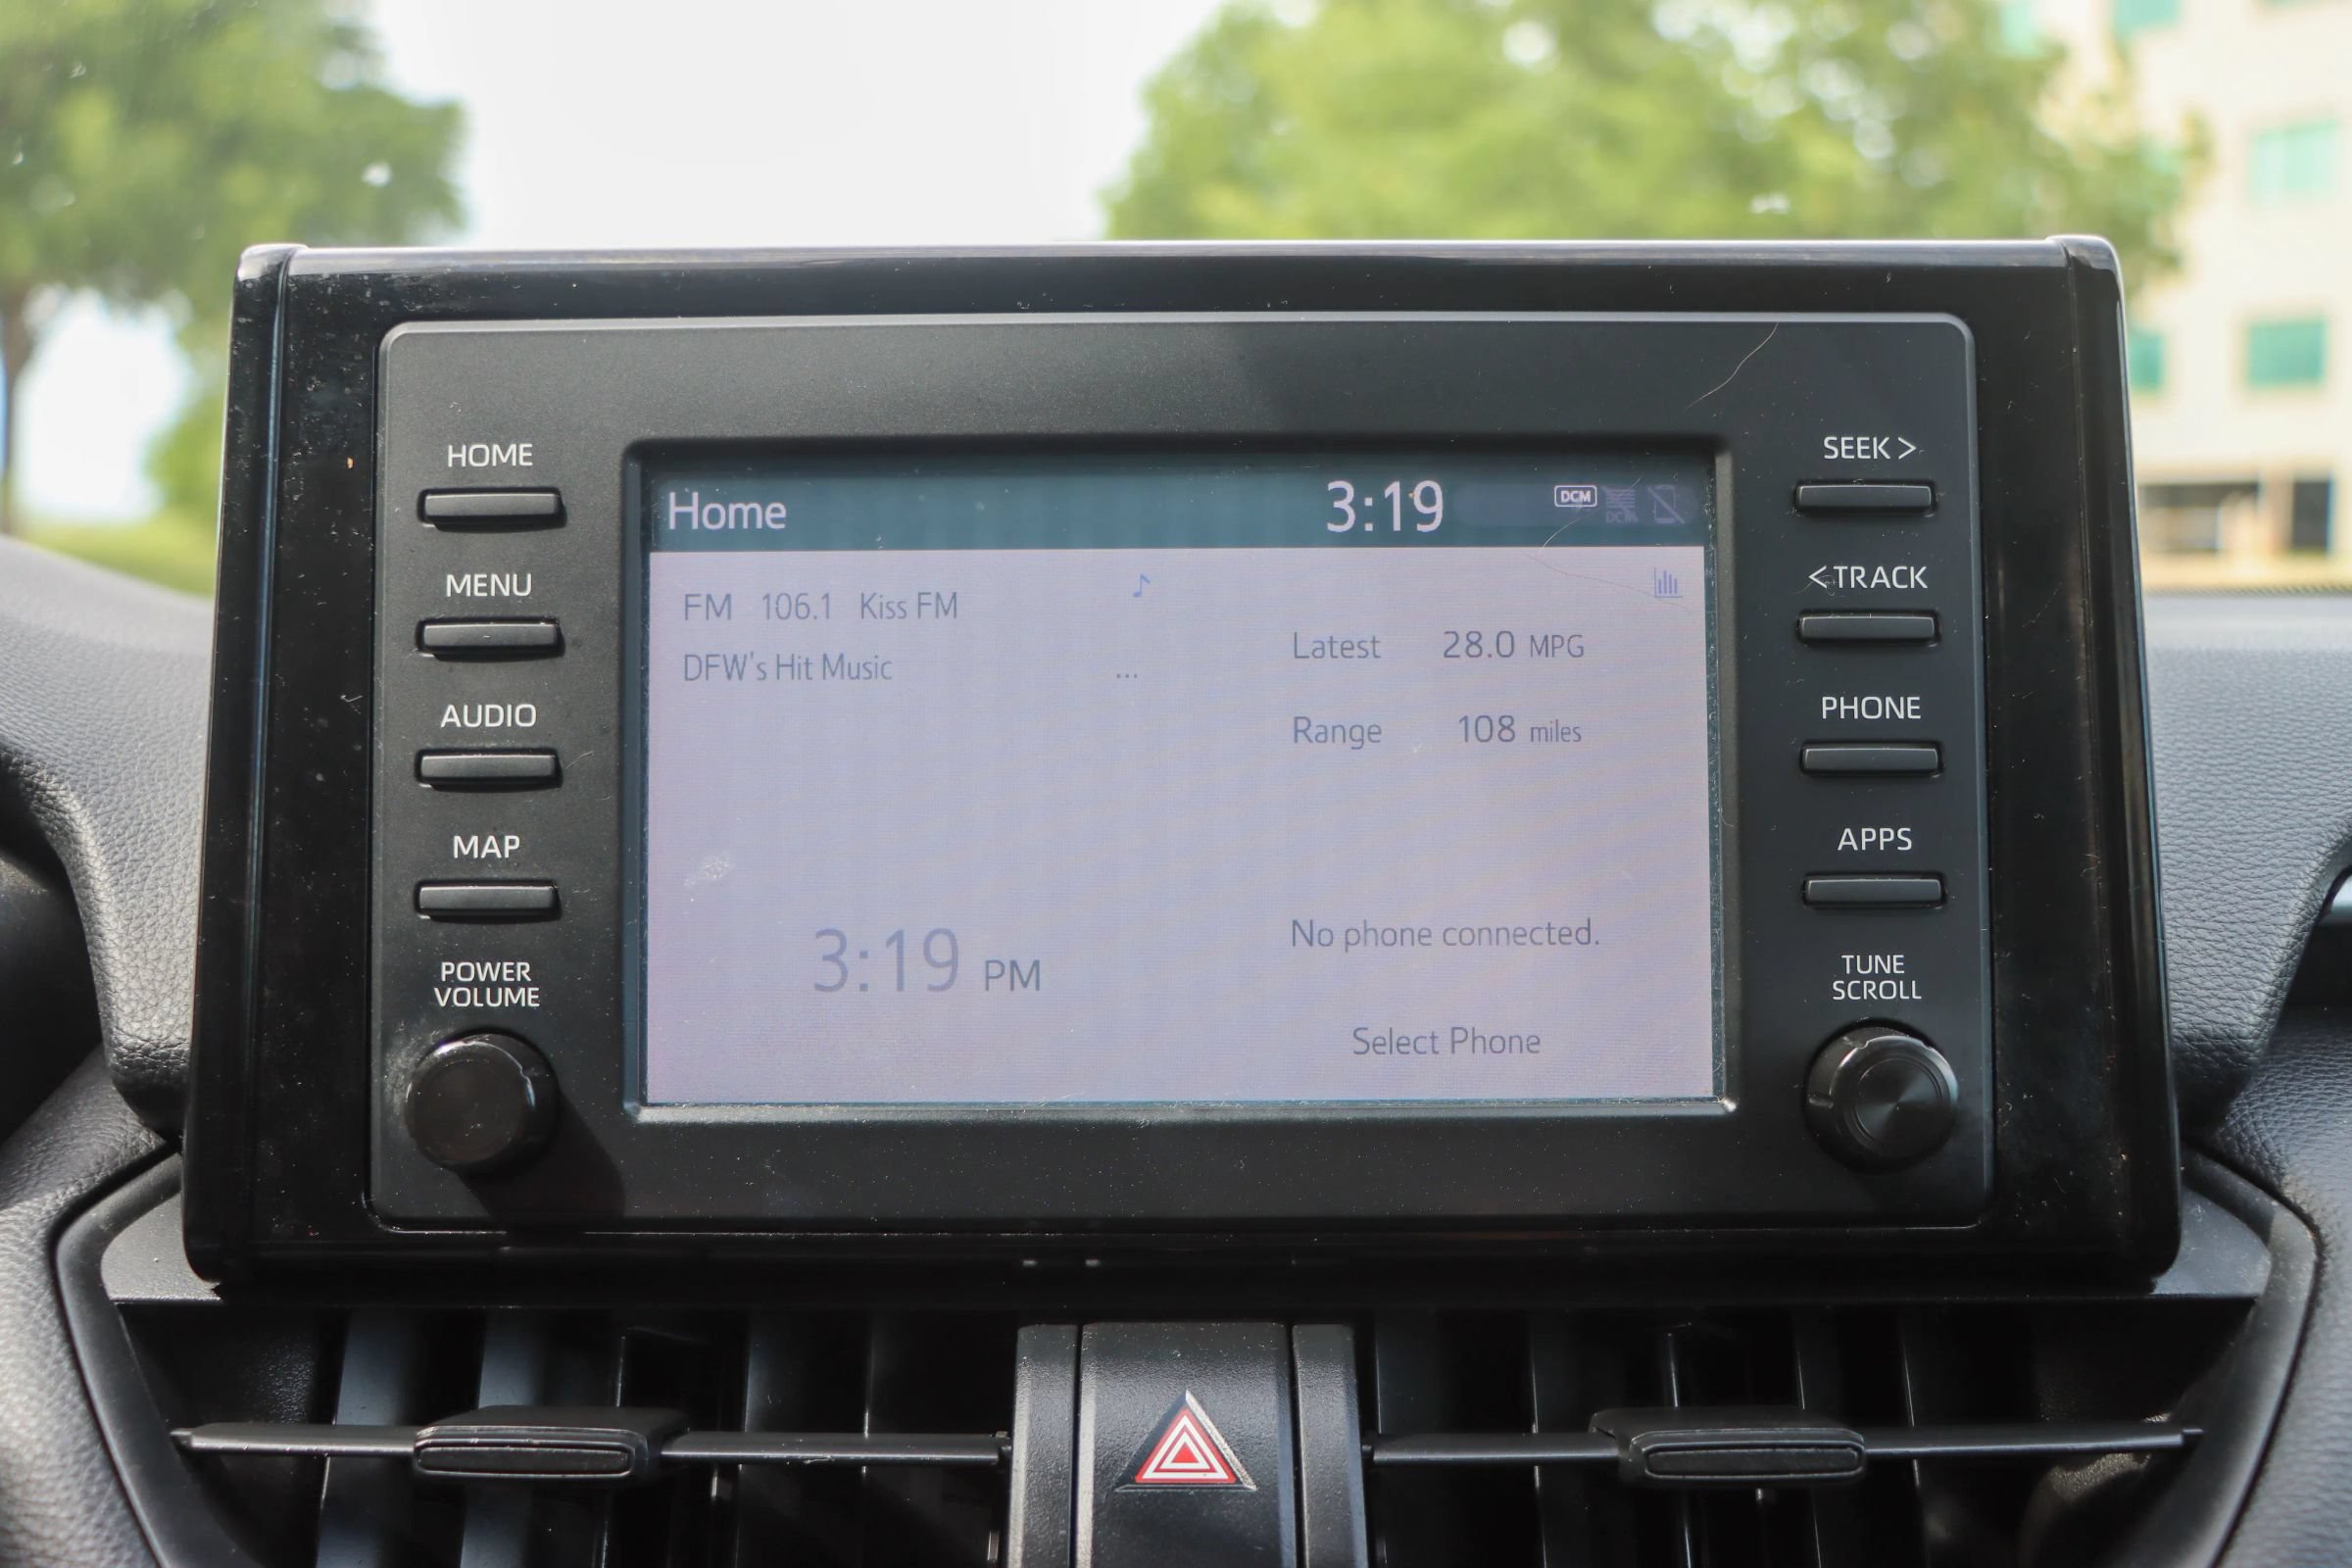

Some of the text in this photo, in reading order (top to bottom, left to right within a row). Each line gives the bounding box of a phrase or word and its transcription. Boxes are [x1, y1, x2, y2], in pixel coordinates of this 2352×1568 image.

[447, 443, 533, 467] HOME
[1326, 479, 1444, 533] 3:19
[1560, 490, 1591, 503] DCM
[668, 491, 787, 530] Home
[446, 573, 532, 598] MENU
[684, 591, 957, 621] FM 106.1 Kiss FM
[1293, 630, 1585, 660] Latest 28.0 MPG
[683, 651, 892, 682] DFW's Hit Music
[440, 703, 537, 728] AUDIO
[1822, 696, 1922, 719] PHONE
[1293, 714, 1583, 751] Range 108 miles
[453, 835, 520, 858] MAP
[1838, 827, 1913, 851] APPS
[1292, 916, 1600, 954] No phone connected.
[441, 961, 531, 982] POWER
[813, 928, 1041, 993] 3:19 PM
[1841, 954, 1905, 975] TUNE
[433, 987, 540, 1007] VOLUME
[1833, 979, 1922, 1001] SCROLL
[1352, 1026, 1542, 1055] Select Phone
